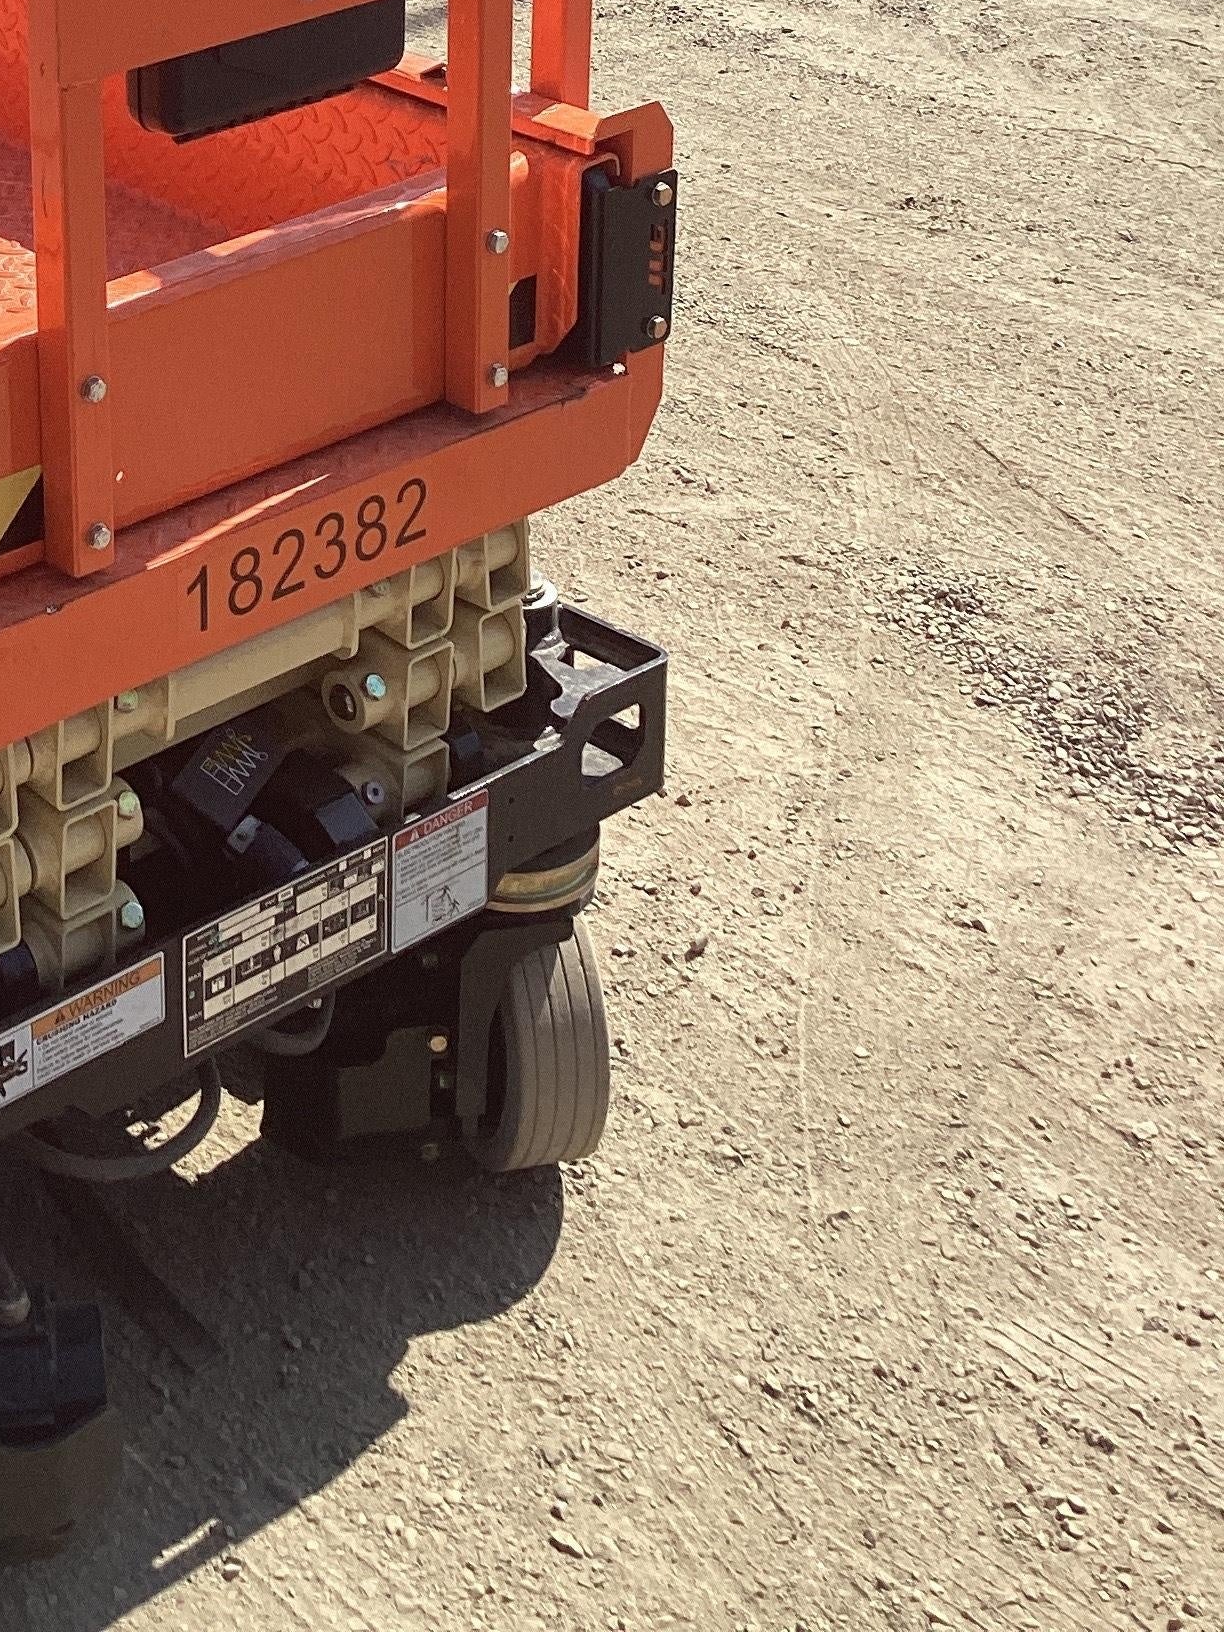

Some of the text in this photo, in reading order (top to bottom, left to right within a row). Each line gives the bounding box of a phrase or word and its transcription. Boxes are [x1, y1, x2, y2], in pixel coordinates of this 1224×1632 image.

[186, 477, 427, 633] 182382
[423, 800, 474, 835] DANGER
[67, 970, 141, 1019] WARNING
